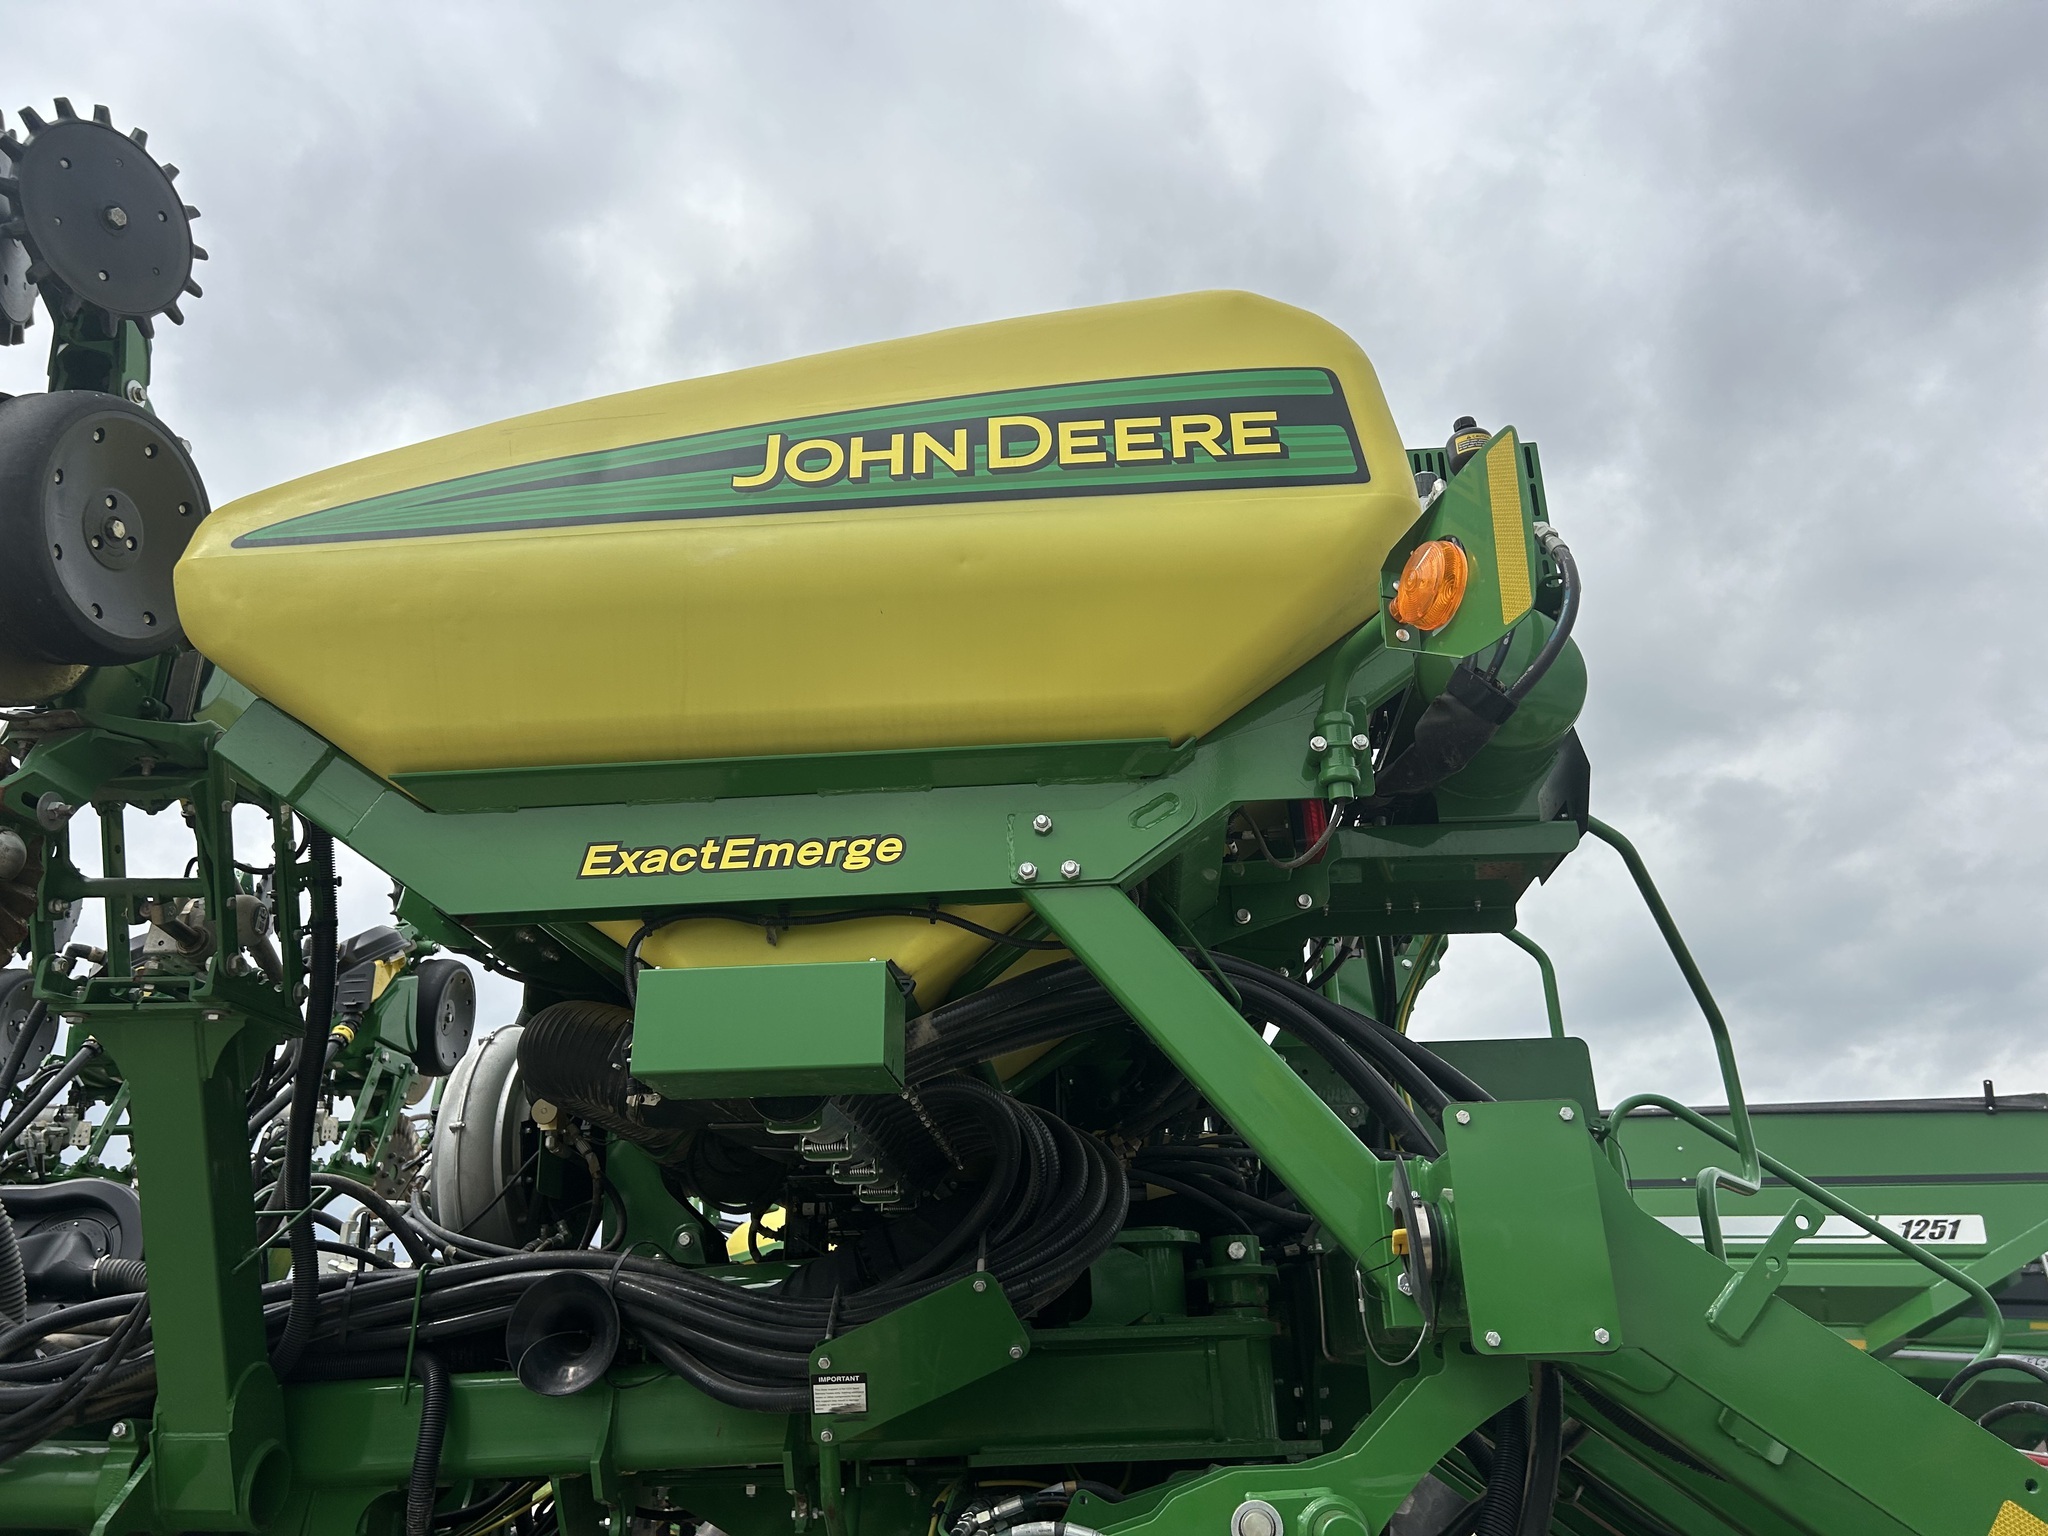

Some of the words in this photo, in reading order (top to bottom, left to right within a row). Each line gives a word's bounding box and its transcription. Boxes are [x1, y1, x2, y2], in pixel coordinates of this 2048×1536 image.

[731, 428, 970, 489] JOHN
[987, 411, 1283, 470] DEERE
[579, 836, 904, 877] ExactEmerge
[1901, 1219, 1961, 1240] 1251
[818, 1375, 860, 1383] IMPORTANT
